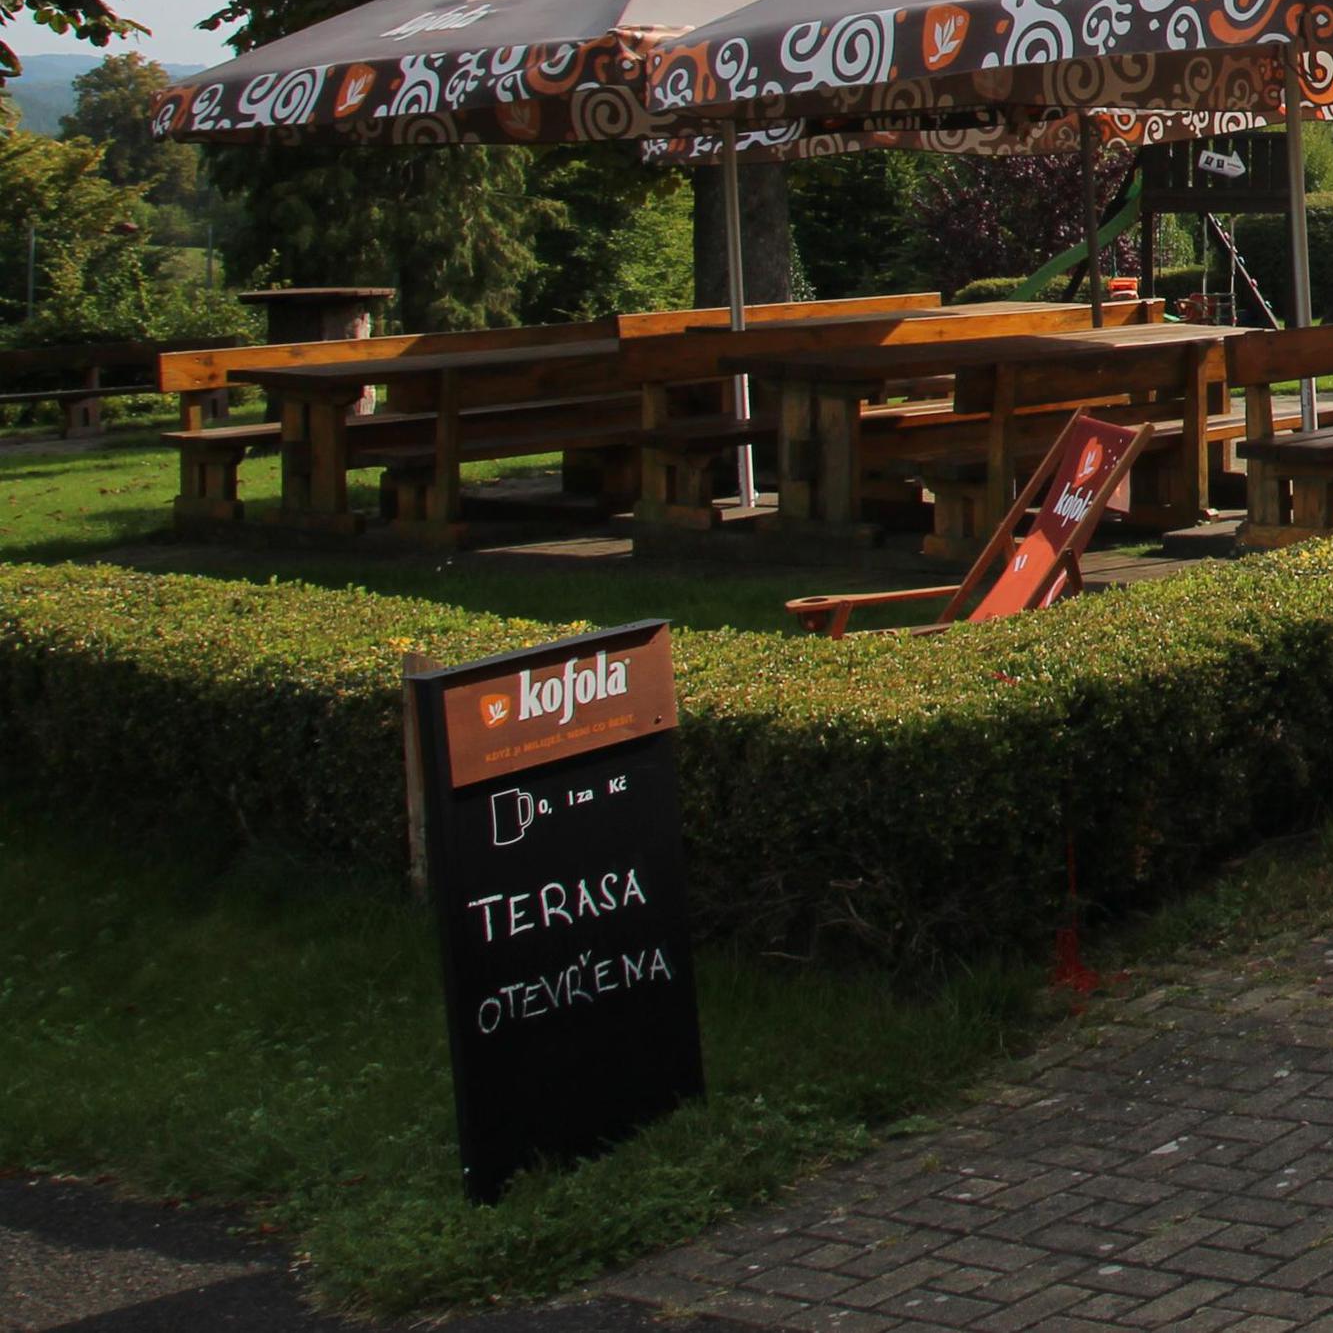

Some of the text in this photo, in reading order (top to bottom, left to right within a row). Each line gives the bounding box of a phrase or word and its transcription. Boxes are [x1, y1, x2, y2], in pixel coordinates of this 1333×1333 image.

[518, 650, 628, 726] kofola
[593, 723, 606, 733] CO
[538, 799, 553, 815] 0,
[577, 789, 594, 804] za
[609, 775, 627, 794] Kč
[468, 868, 647, 942] TERASA
[478, 948, 672, 1034] OTEVŘENA
